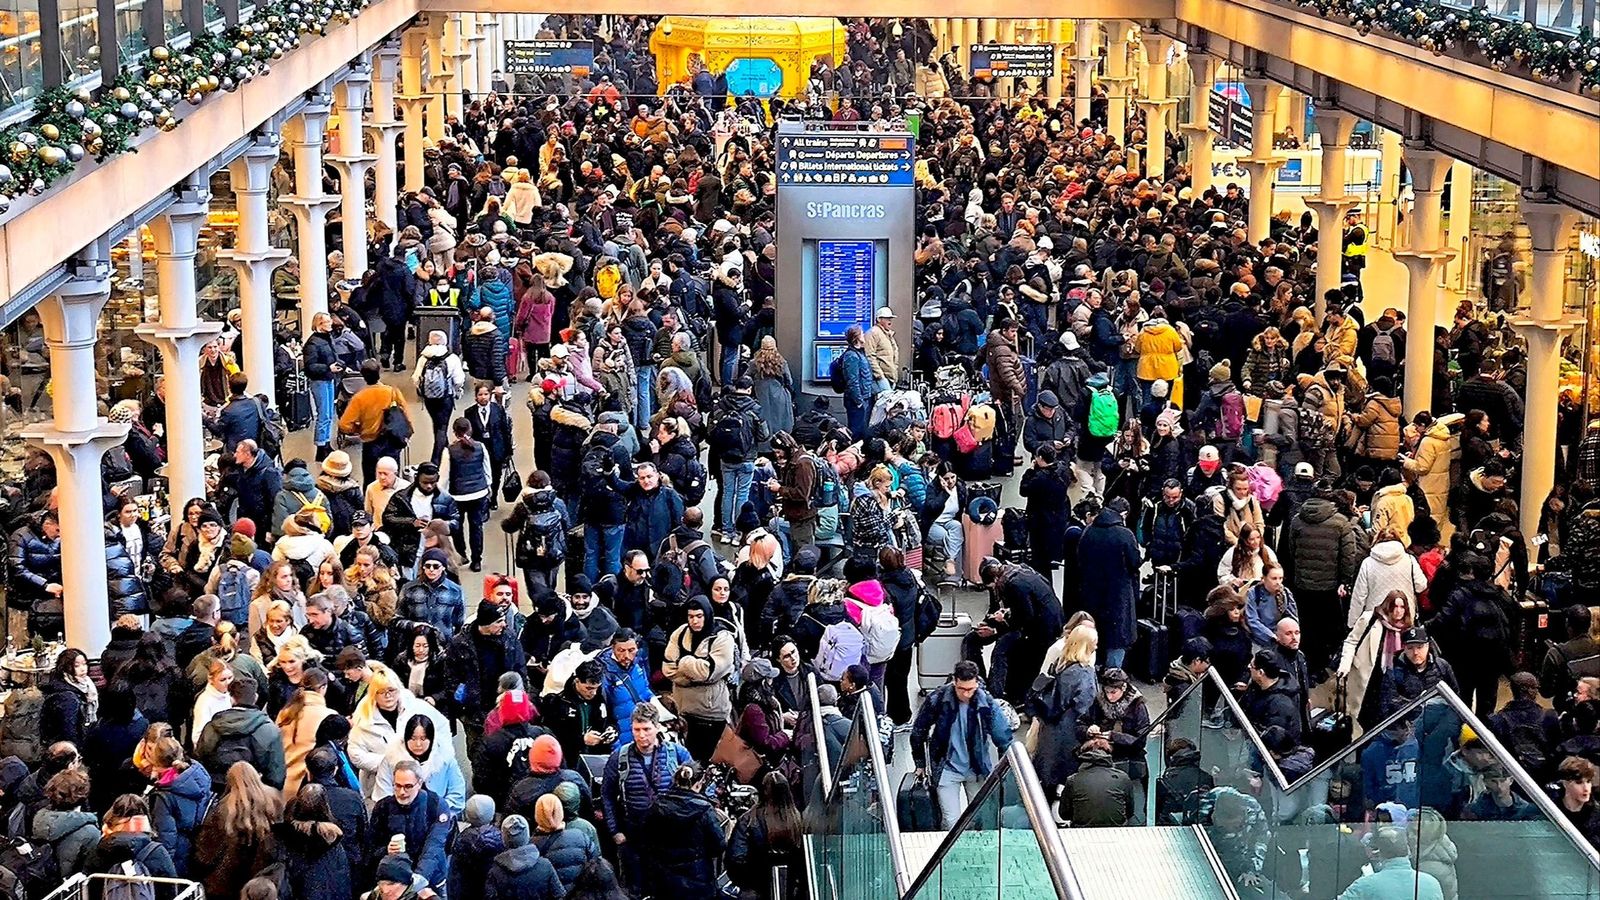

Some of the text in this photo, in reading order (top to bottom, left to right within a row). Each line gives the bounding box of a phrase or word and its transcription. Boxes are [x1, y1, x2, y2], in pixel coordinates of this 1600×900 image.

[793, 139, 804, 147] All
[806, 139, 828, 147] trains
[825, 150, 855, 160] Départs
[856, 150, 898, 160] Departures
[798, 162, 898, 171] Billets International tickets
